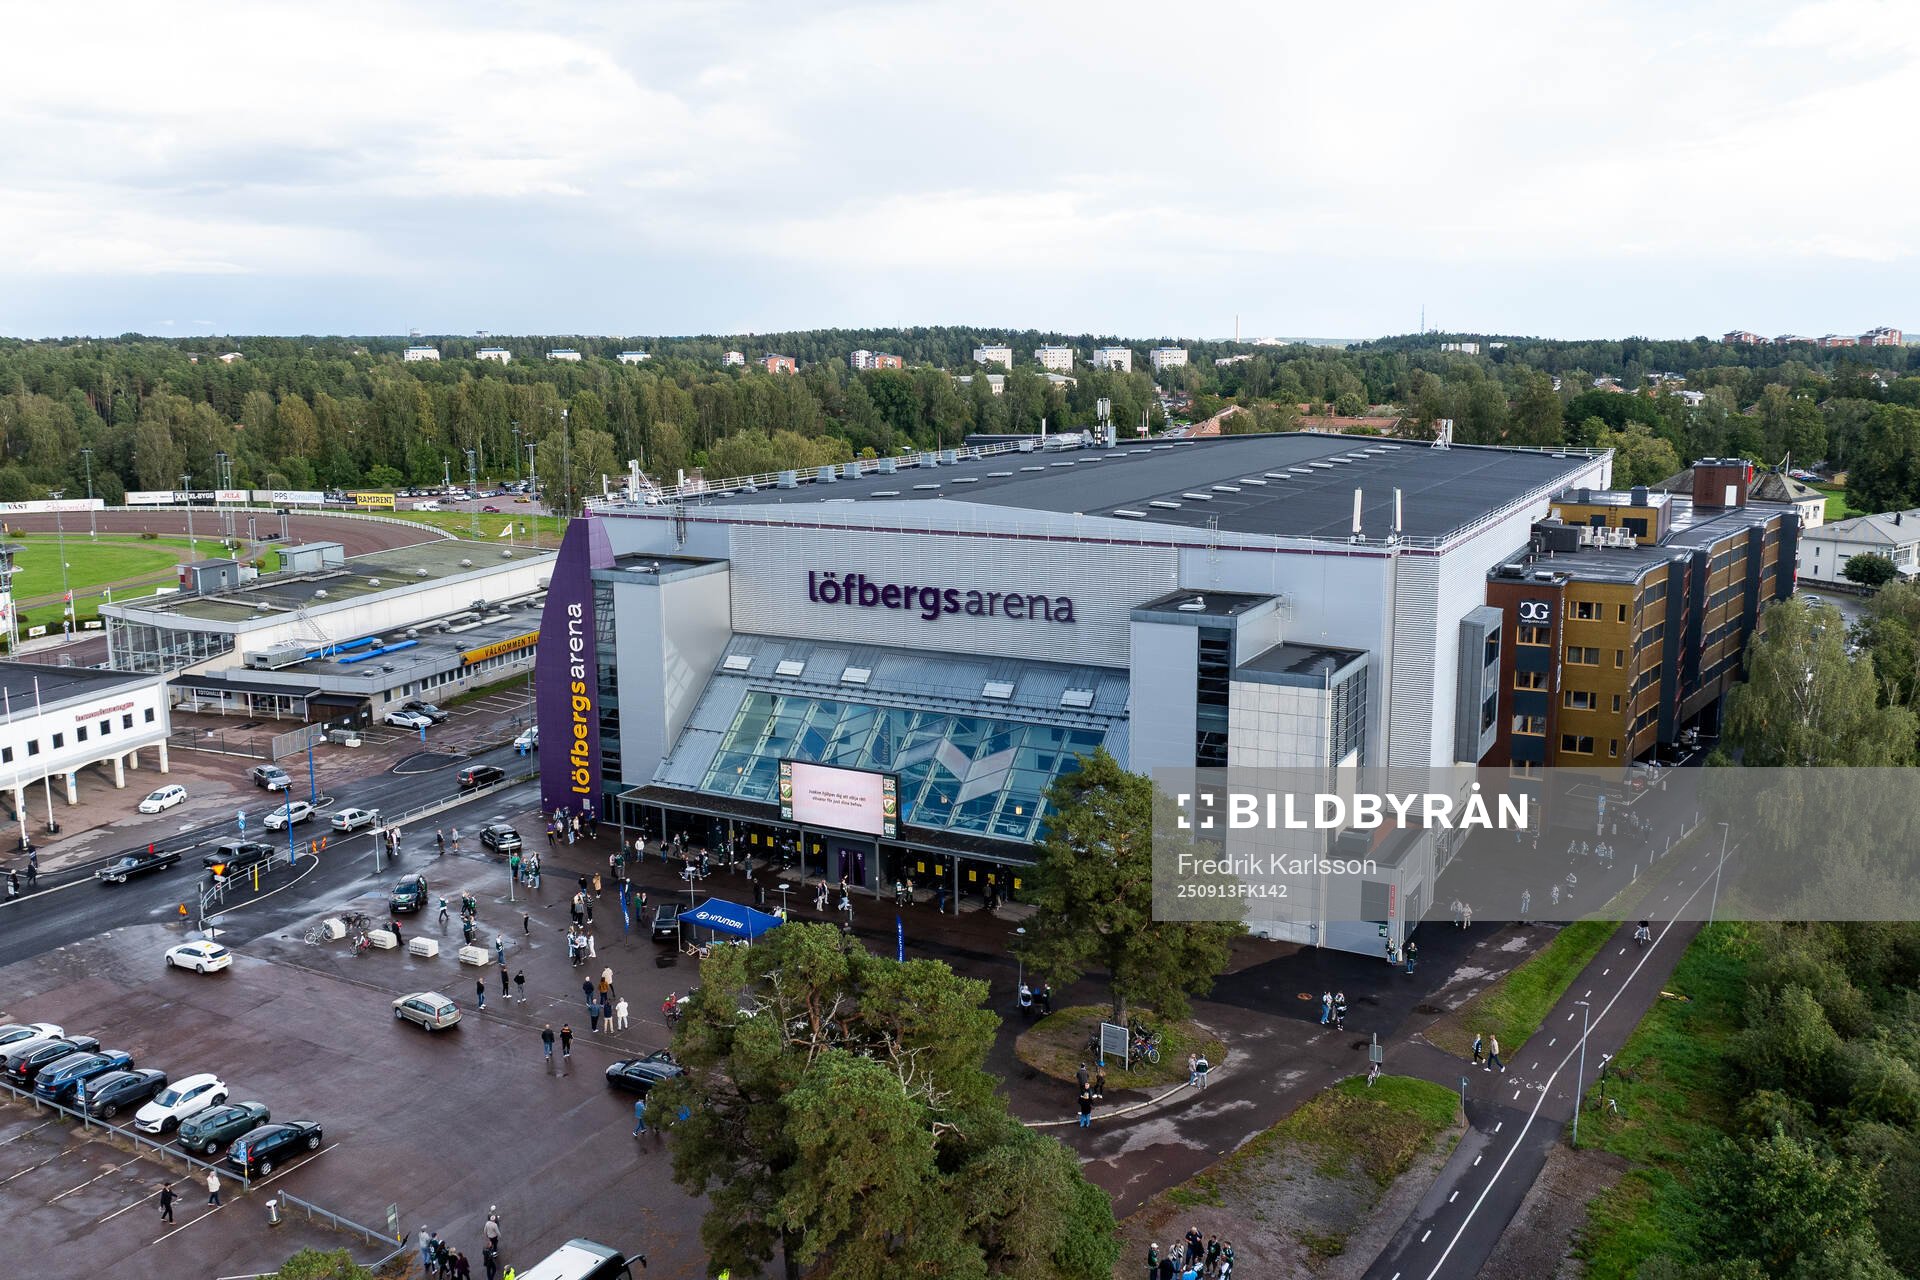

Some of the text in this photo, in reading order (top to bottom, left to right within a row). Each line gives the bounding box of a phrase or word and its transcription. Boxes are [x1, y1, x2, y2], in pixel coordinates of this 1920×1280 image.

[274, 492, 288, 500] PPS
[358, 495, 393, 504] RAMIRENT
[808, 570, 1076, 623] löfbergsarena
[484, 639, 526, 656] VÄLKOMMEN
[568, 602, 592, 794] löfbergsarena
[709, 914, 744, 930] HYUNDAI
